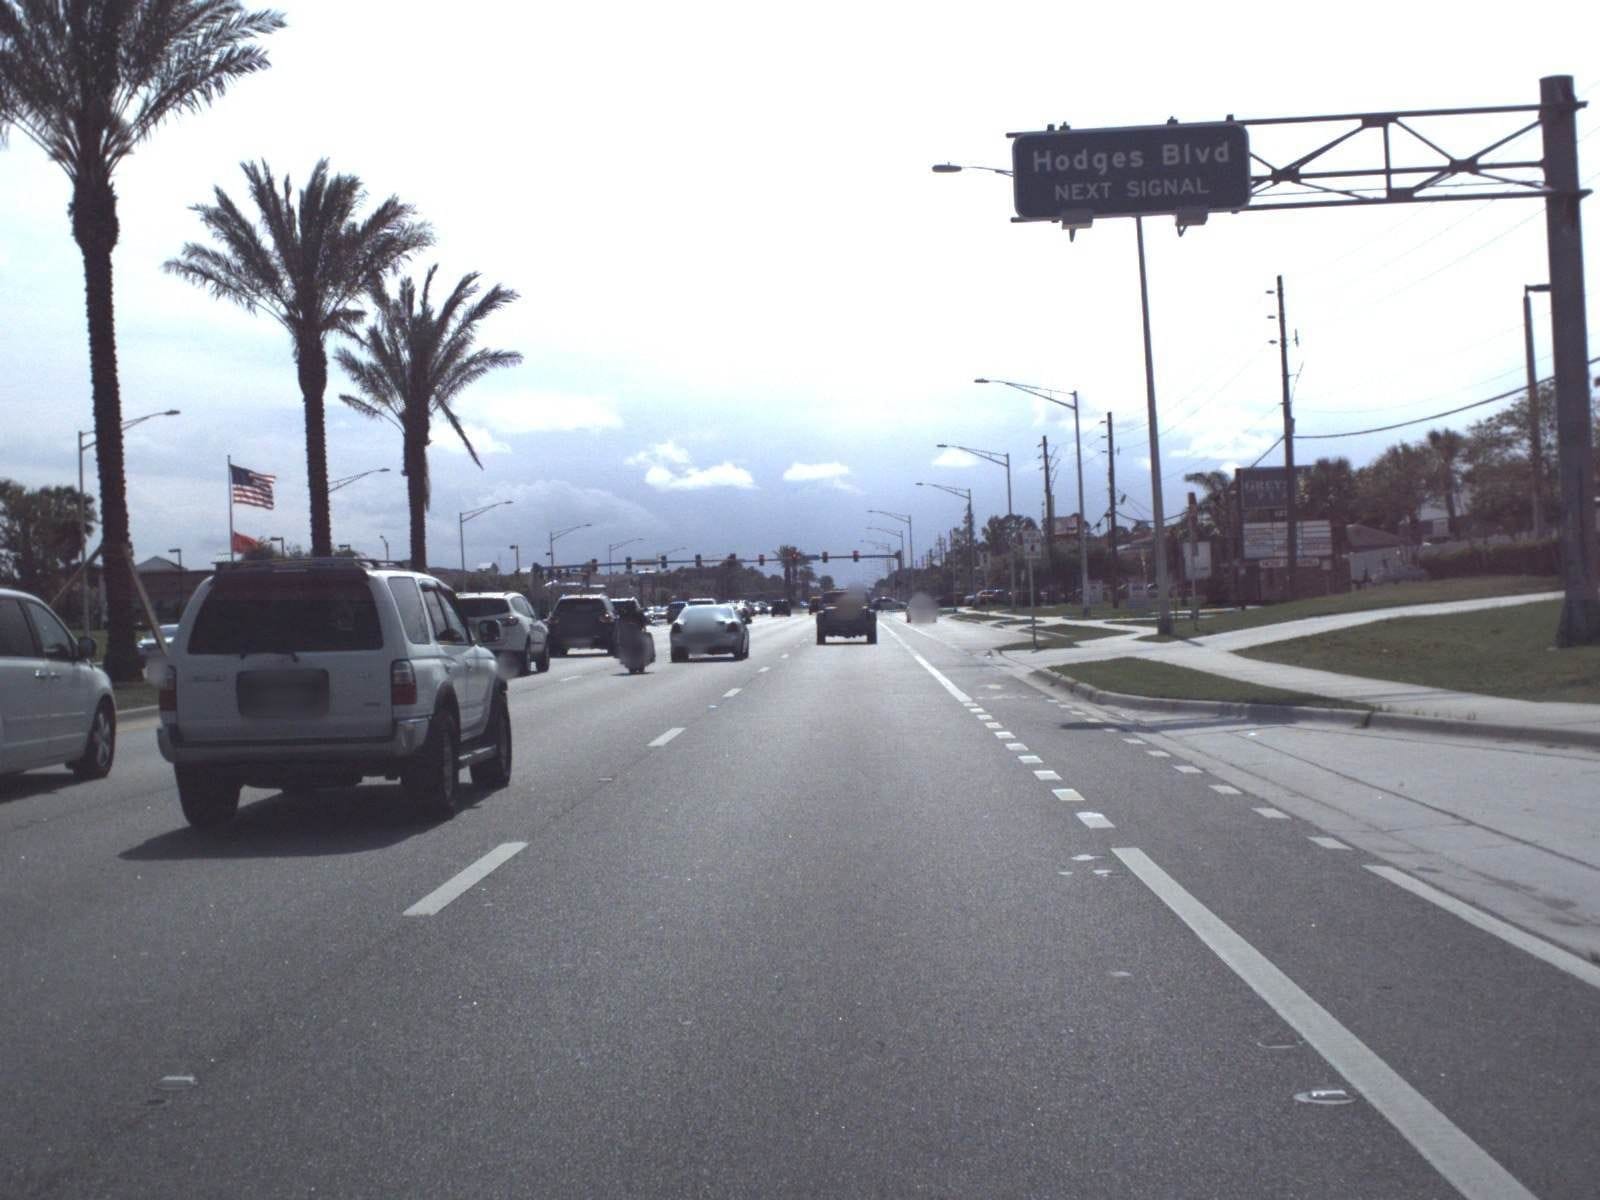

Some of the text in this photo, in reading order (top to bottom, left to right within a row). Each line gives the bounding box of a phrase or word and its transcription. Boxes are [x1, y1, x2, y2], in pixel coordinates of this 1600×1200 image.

[1033, 141, 1230, 175] Hodges Blvd
[1054, 178, 1210, 201] NEXT SIGNAL
